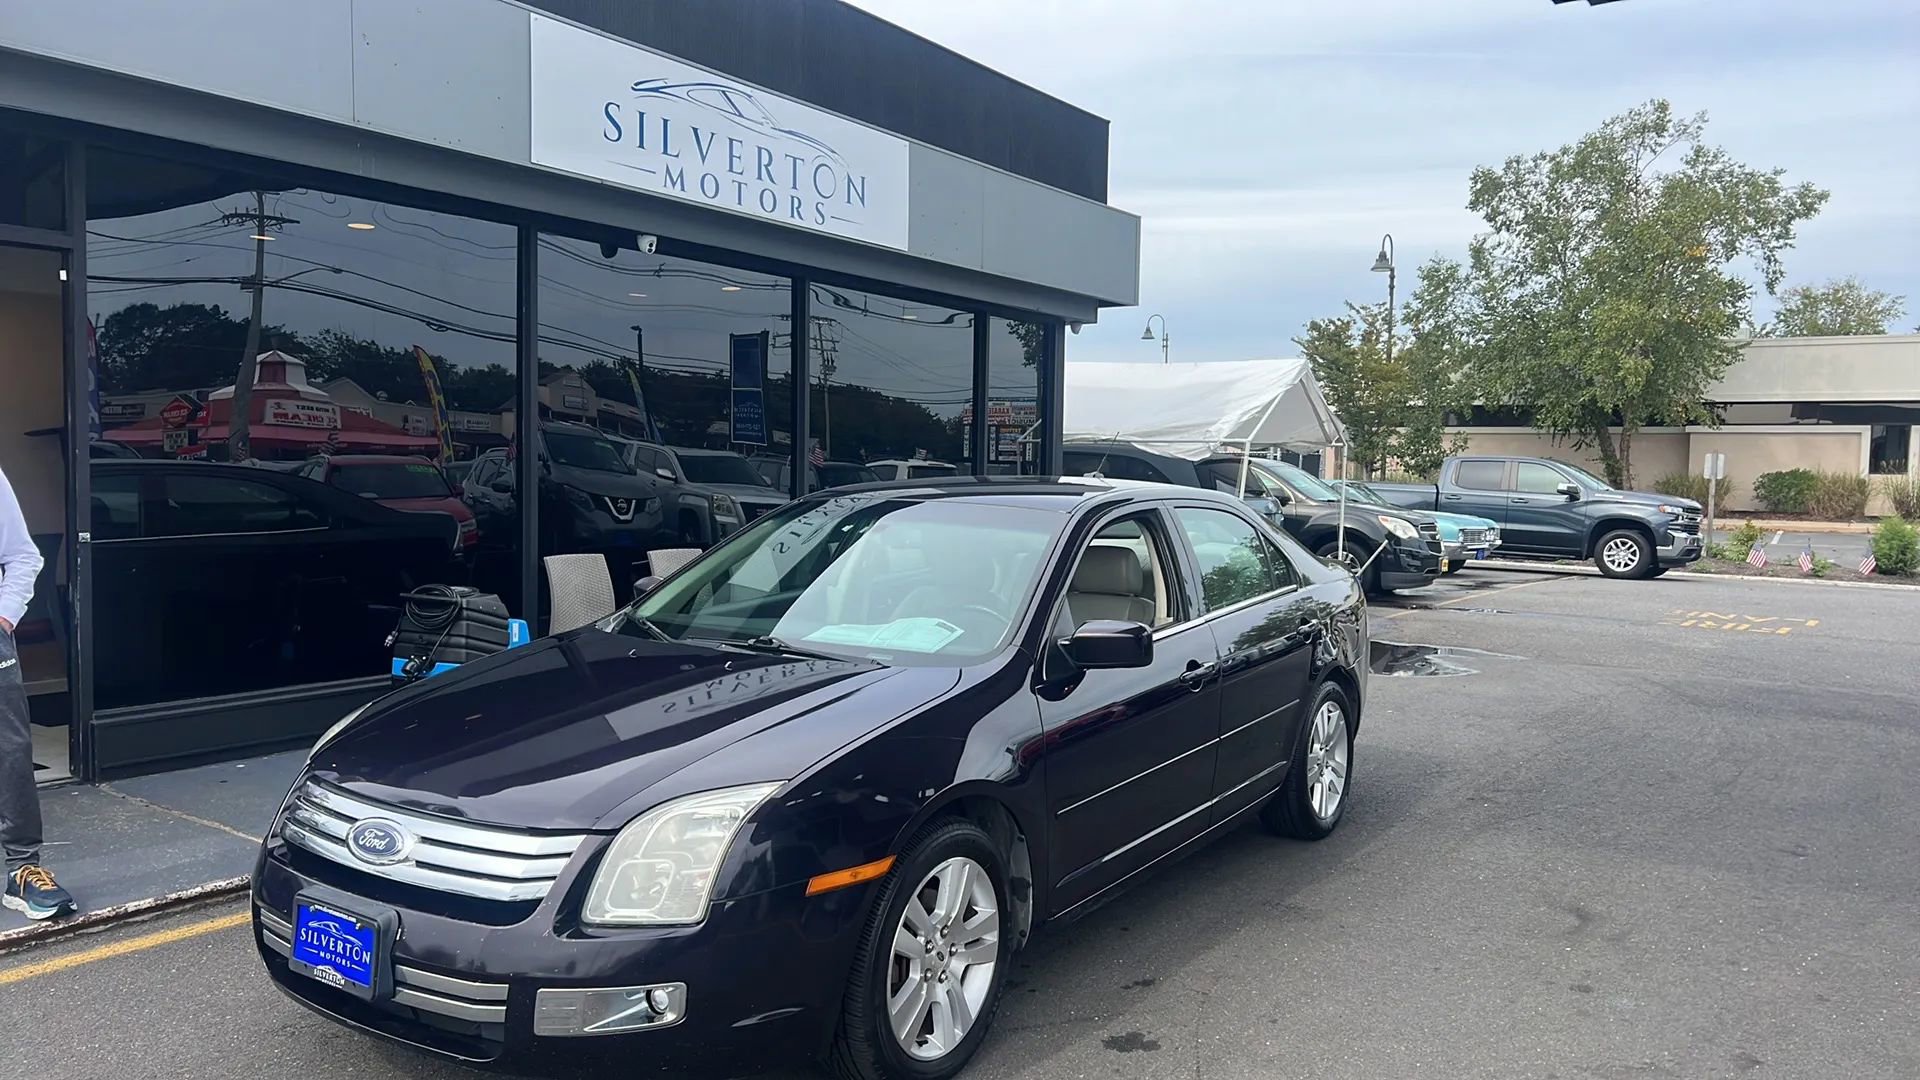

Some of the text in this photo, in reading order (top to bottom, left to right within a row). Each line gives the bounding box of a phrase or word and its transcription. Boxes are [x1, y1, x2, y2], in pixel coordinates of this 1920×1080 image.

[603, 101, 867, 208] SILVERTON
[663, 163, 826, 226] MOTORS
[358, 828, 390, 851] Ford
[300, 927, 371, 965] SILVERTON
[319, 950, 351, 968] MOTORS
